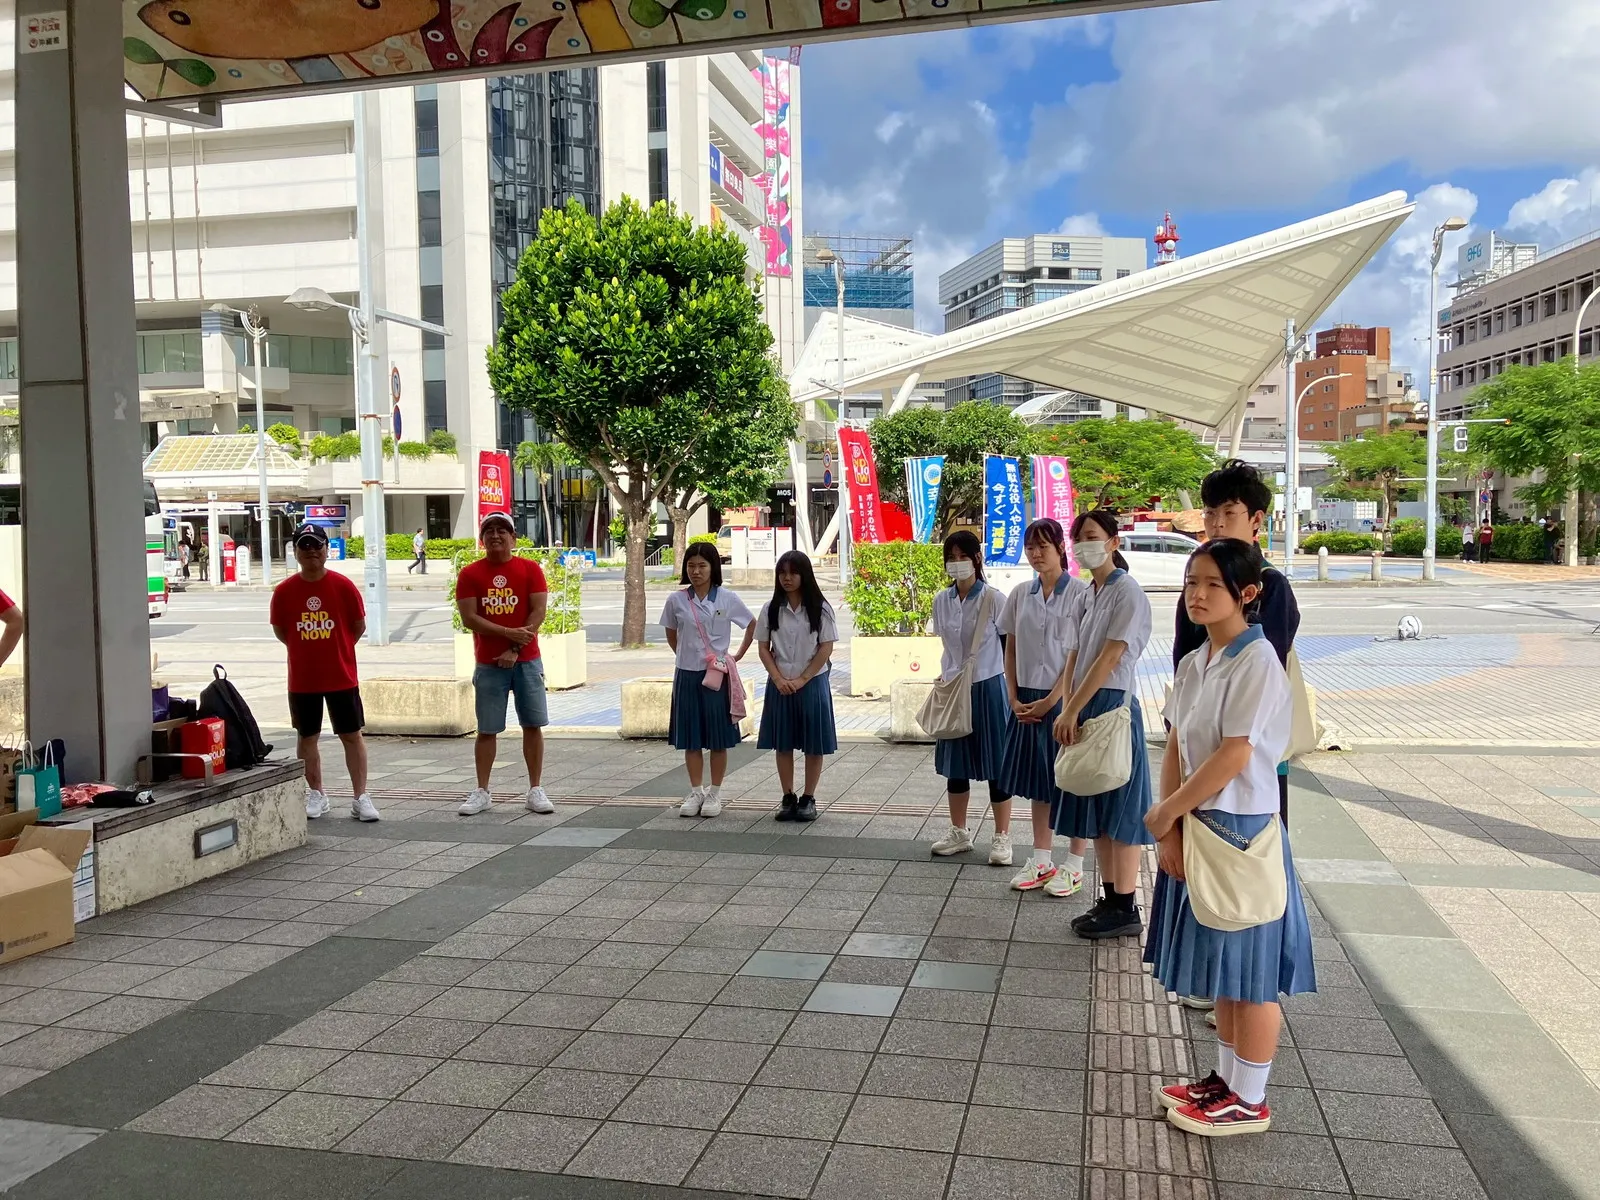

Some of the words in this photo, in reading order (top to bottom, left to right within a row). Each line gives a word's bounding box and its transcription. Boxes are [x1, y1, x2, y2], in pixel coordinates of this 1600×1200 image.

[482, 478, 500, 489] END
[1005, 463, 1022, 557] 無駄な役人や役所を
[487, 588, 514, 598] END
[481, 595, 519, 607] POLIO
[485, 605, 515, 615] NOW
[301, 611, 329, 622] END
[296, 619, 335, 632] POLIO
[300, 629, 331, 641] NOW
